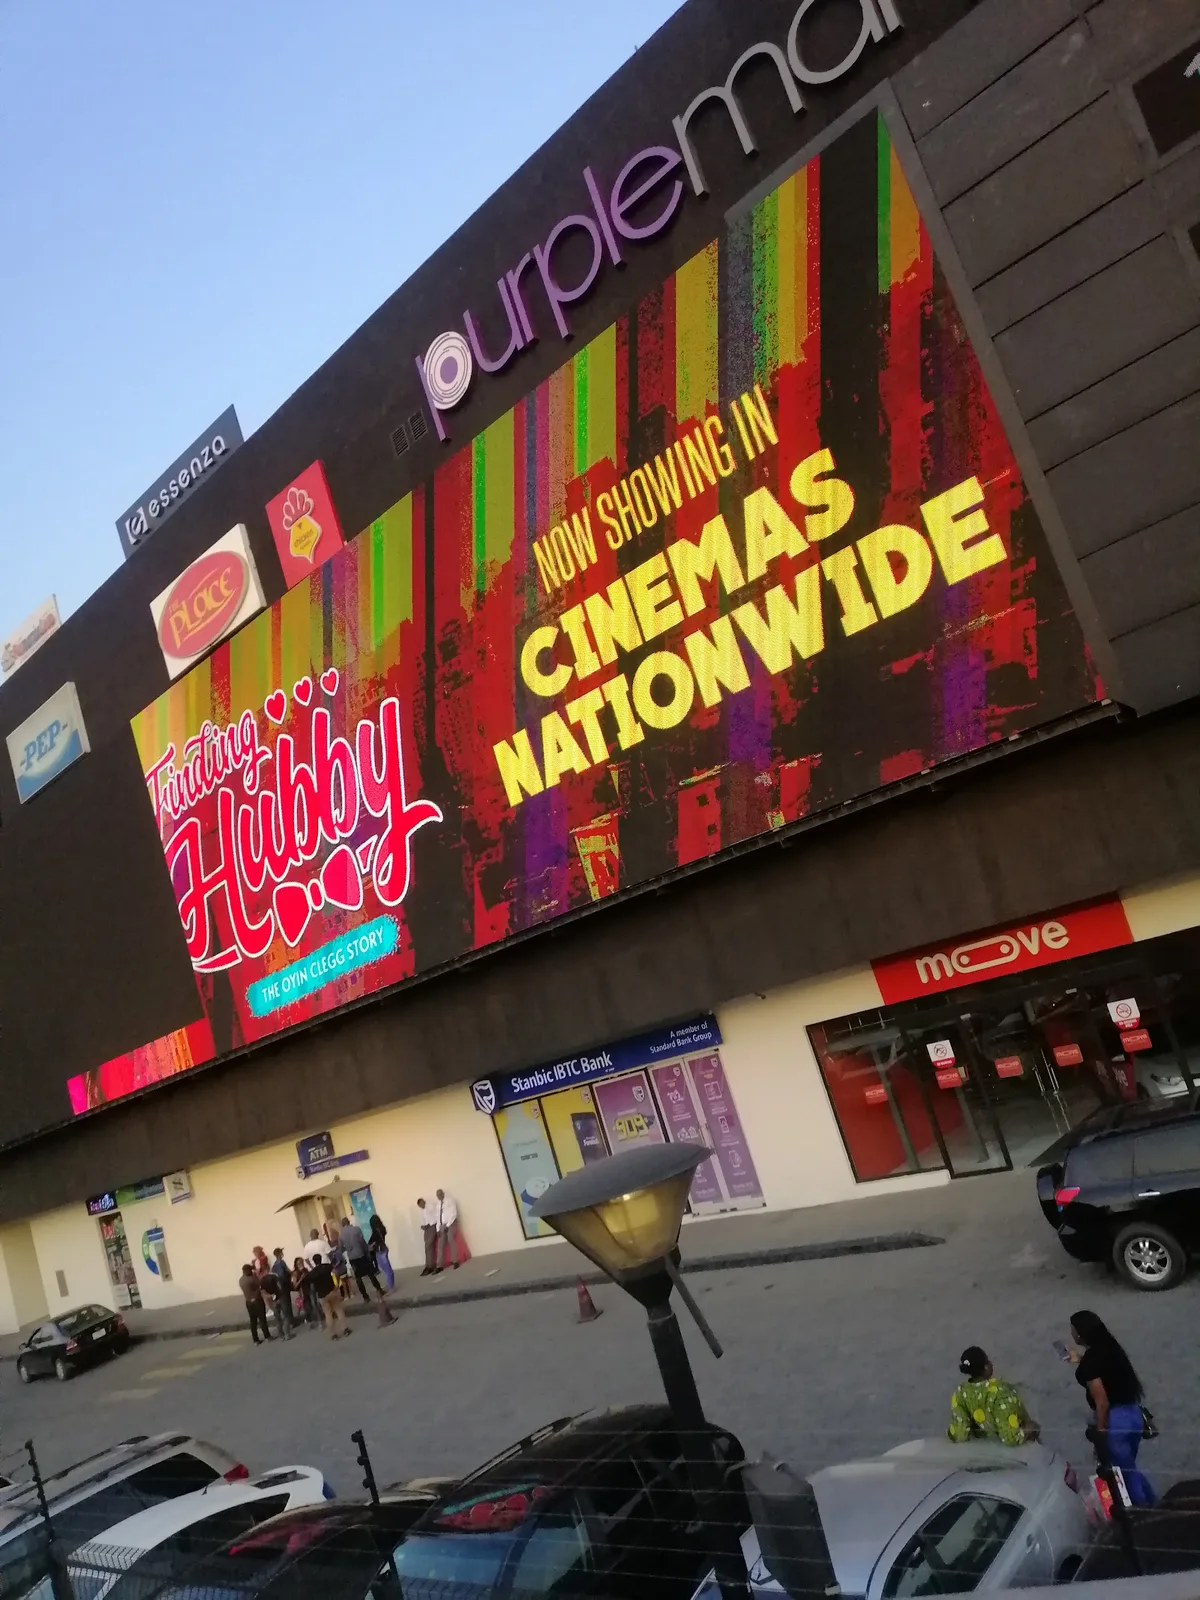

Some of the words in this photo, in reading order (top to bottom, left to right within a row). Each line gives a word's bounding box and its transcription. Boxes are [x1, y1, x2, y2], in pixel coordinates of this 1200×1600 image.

[148, 434, 227, 518] essenza
[533, 521, 598, 595] NOW
[596, 414, 736, 551] SHOWING
[730, 383, 780, 462] IN
[520, 447, 856, 698] CINEMAS
[492, 475, 1009, 808] NATIONWIDE
[145, 709, 273, 836] Finding
[164, 697, 444, 974] Hubby
[261, 982, 281, 1003] THE
[281, 967, 309, 993] OYIN
[310, 948, 345, 979] CLEGG
[346, 925, 384, 960] STORY
[649, 1040, 676, 1054] Standard
[676, 1036, 693, 1047] Bank
[692, 1031, 713, 1042] Group
[670, 1030, 676, 1039] A
[676, 1024, 700, 1037] member
[701, 1020, 709, 1030] of
[511, 1068, 554, 1093] Stanbic
[553, 1059, 581, 1081] IBTC
[580, 1051, 613, 1074] Bank
[309, 1146, 328, 1161] ATM
